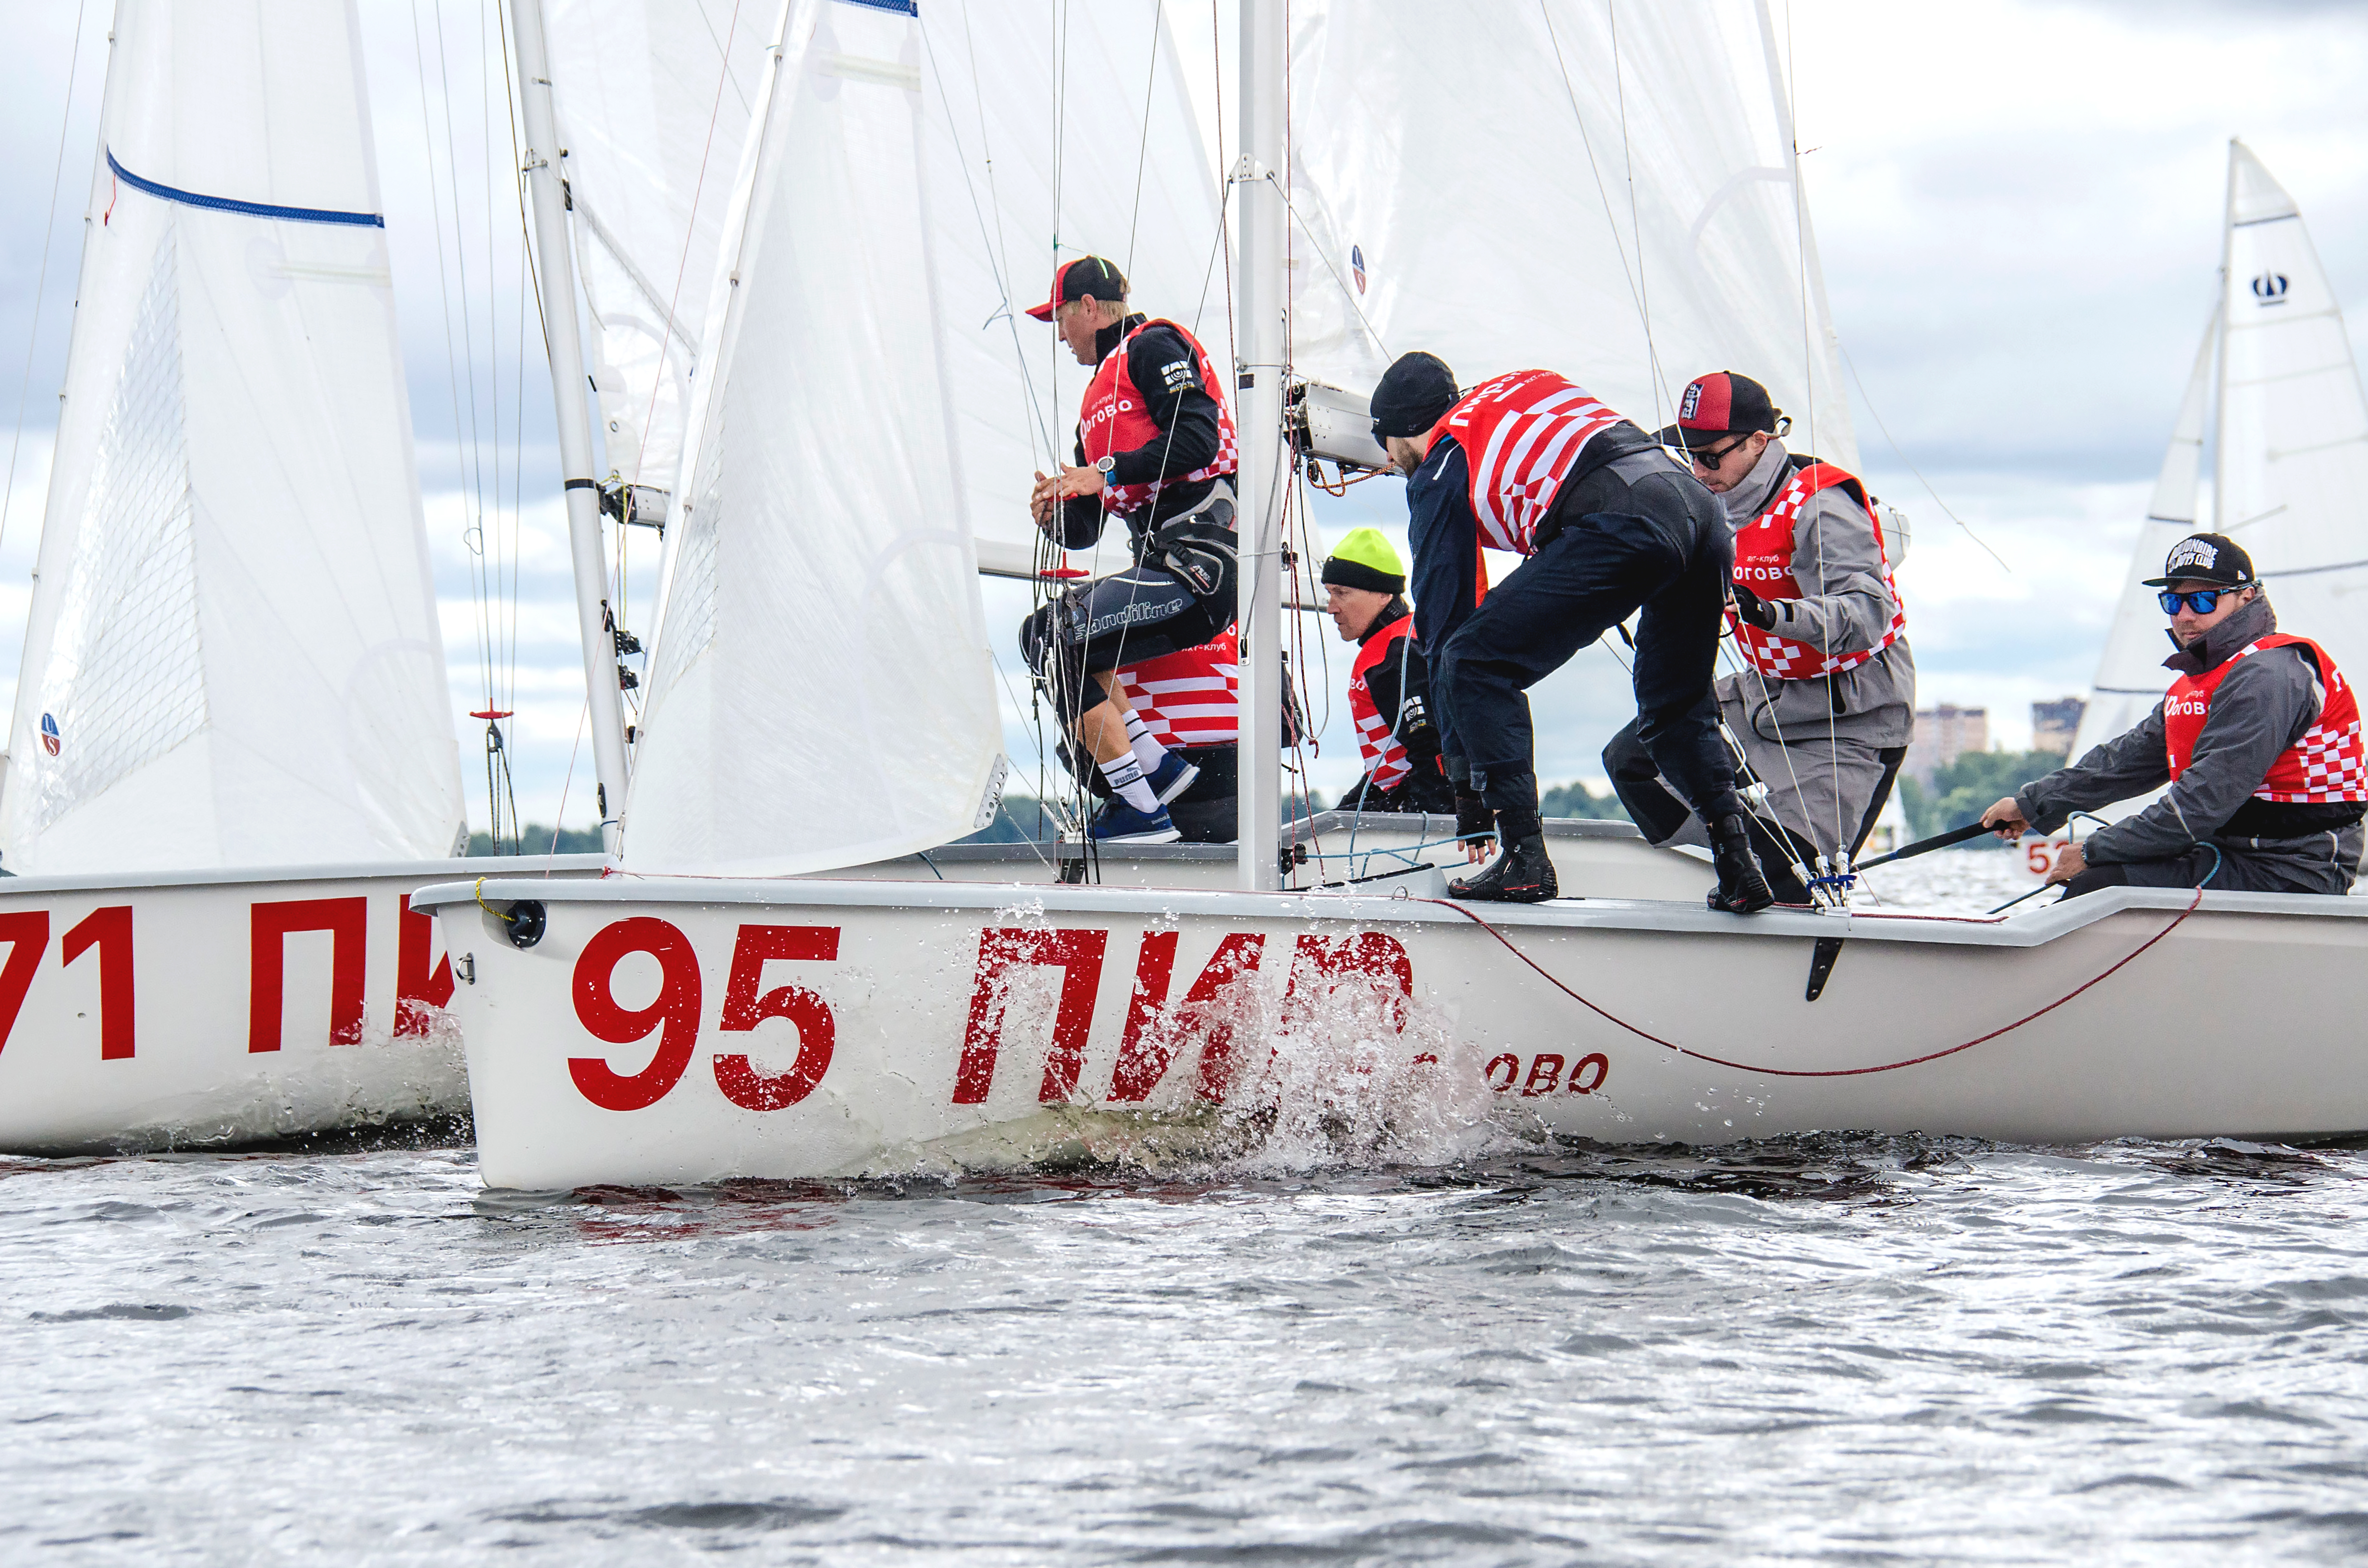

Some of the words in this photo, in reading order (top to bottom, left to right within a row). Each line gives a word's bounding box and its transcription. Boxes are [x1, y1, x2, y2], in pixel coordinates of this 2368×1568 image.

[1114, 770, 1139, 785] PUMA
[2029, 840, 2070, 874] 5
[0, 906, 135, 1065] 71
[567, 917, 841, 1112] 95
